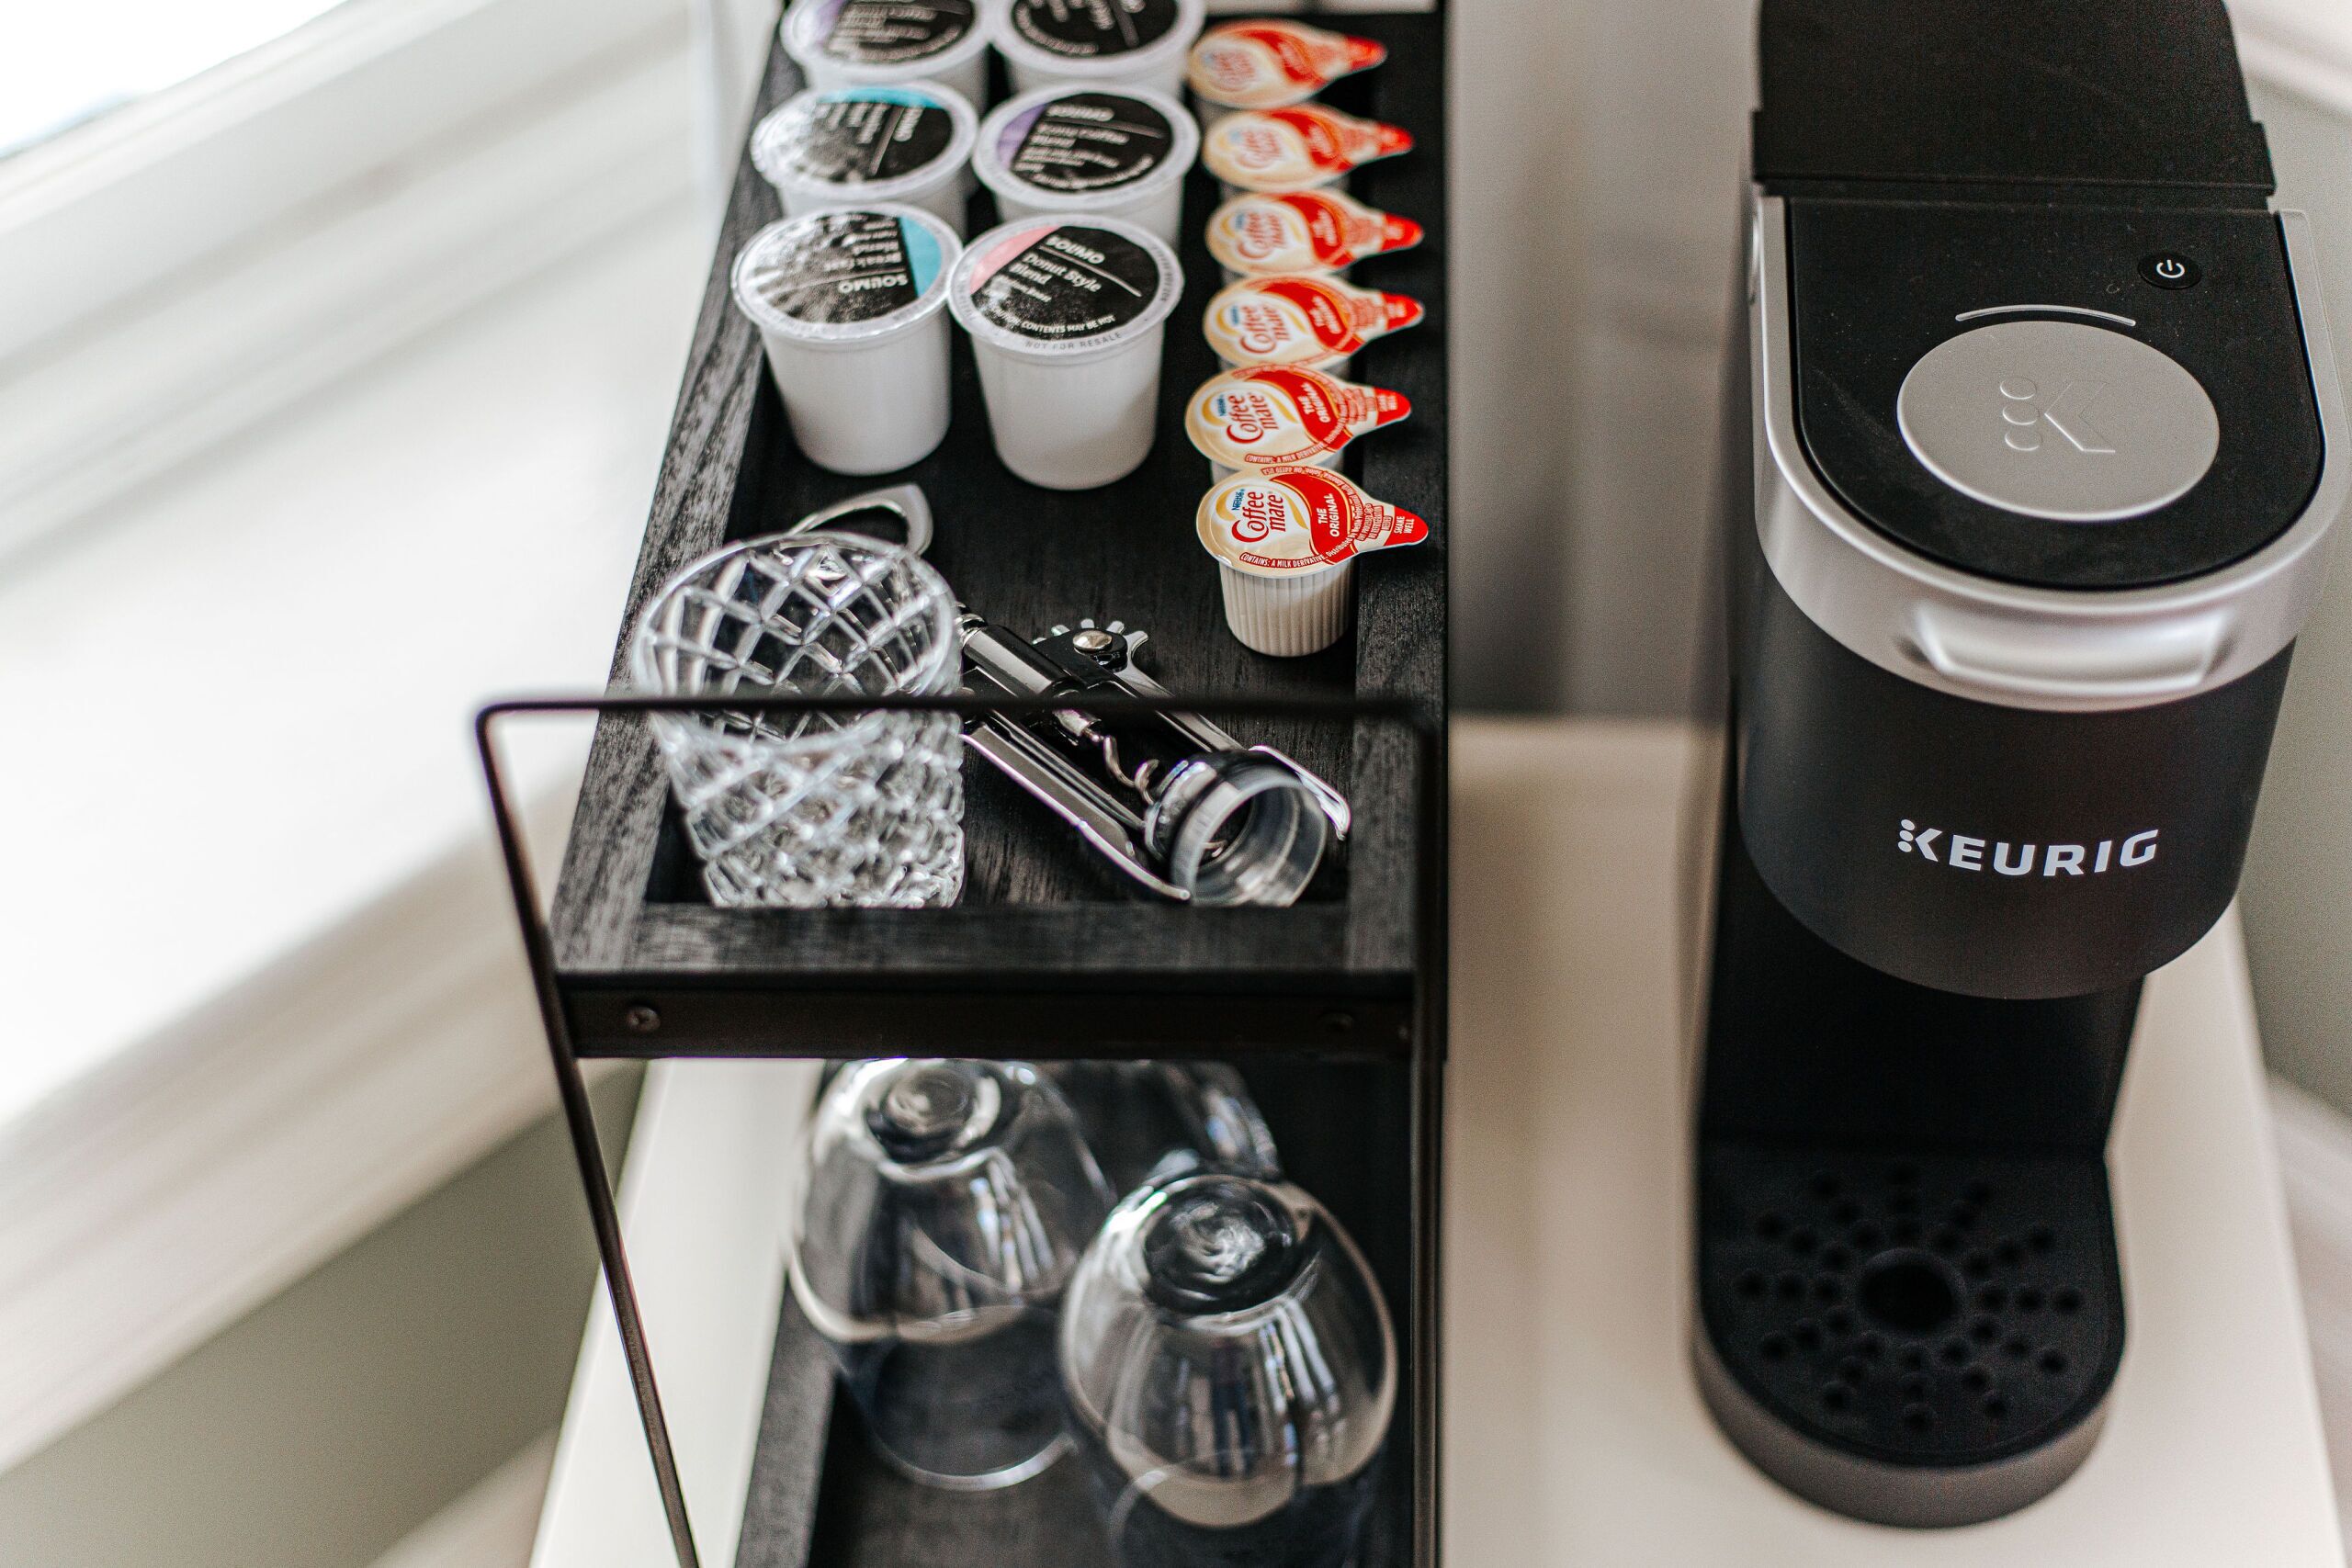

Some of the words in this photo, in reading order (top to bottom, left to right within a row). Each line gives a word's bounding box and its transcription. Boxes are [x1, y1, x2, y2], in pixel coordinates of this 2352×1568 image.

[1022, 253, 1068, 276] Donut
[1064, 269, 1102, 292] Style
[1022, 321, 1066, 333] CONTENTS
[1067, 322, 1085, 333] MAY
[1086, 319, 1098, 329] BE
[1097, 314, 1116, 325] HOT
[1025, 340, 1048, 350] NOT
[1052, 343, 1074, 351] FOR
[1080, 333, 1122, 348] RESALE
[1227, 395, 1263, 444] Coffee
[1249, 394, 1279, 430] mate
[1297, 395, 1316, 415] THE
[1300, 381, 1331, 423] ORIGINAL
[1231, 491, 1270, 543] Coffee
[1267, 493, 1287, 532] mate
[1317, 508, 1329, 525] THE
[1323, 492, 1340, 537] ORIGINAL
[1393, 516, 1406, 534] SHAKE
[1402, 519, 1415, 534] WELL
[1240, 553, 1270, 567] CONTAINS:
[1276, 558, 1291, 568] MILK
[1897, 818, 2159, 876] KEURIG
